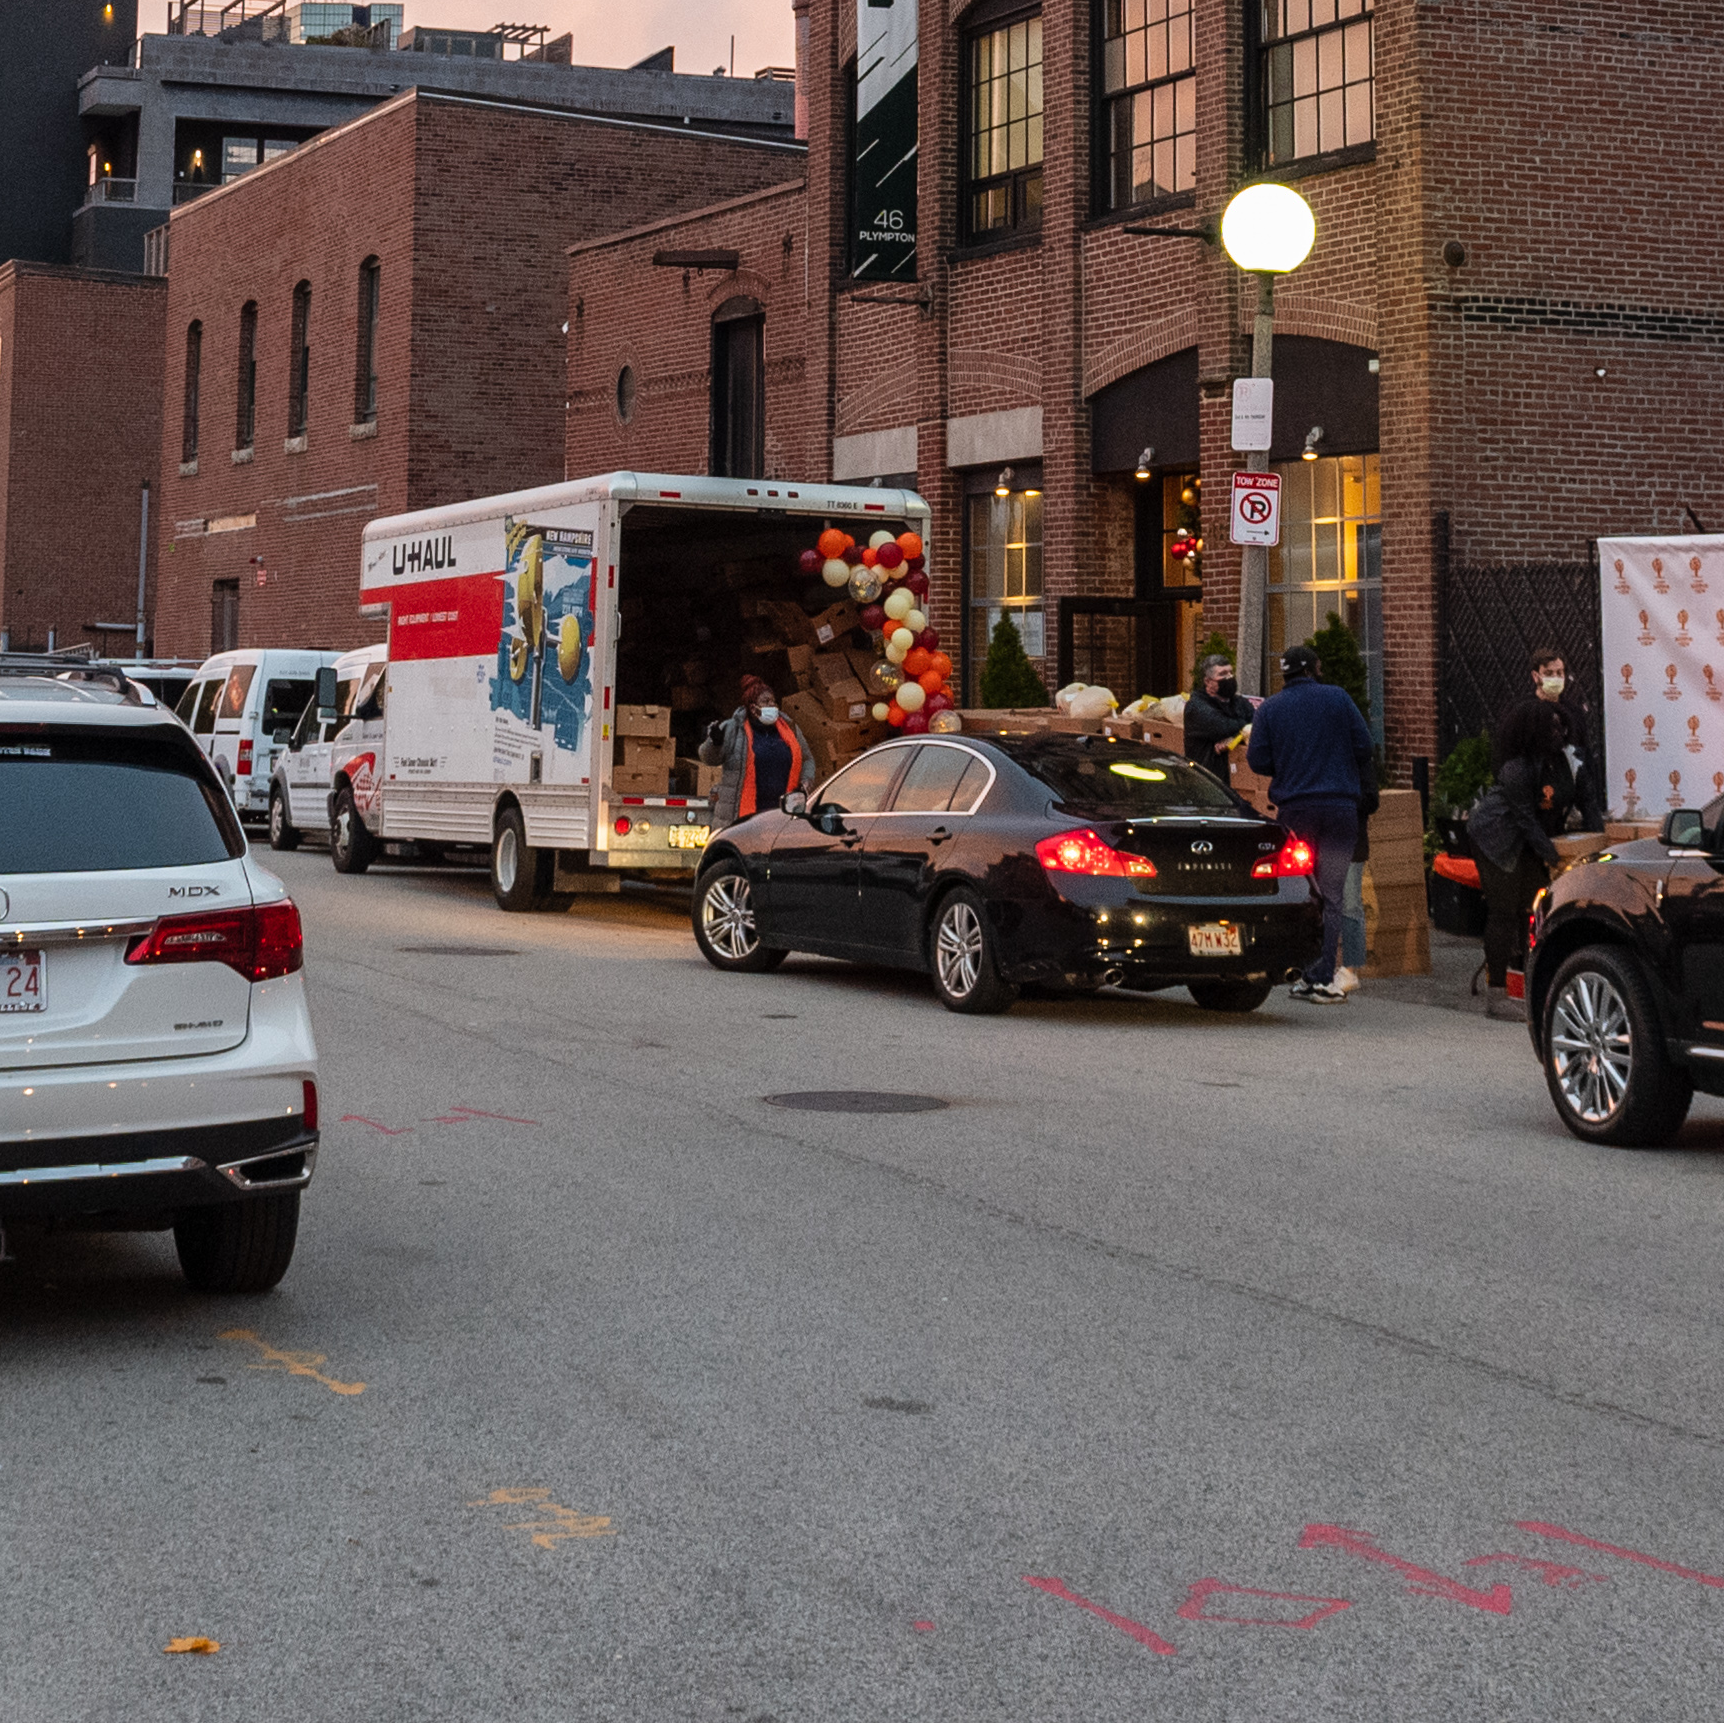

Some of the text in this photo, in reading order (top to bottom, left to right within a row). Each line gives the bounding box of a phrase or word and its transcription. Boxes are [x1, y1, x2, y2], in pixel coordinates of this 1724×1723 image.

[874, 209, 904, 230] 46
[859, 231, 915, 243] PLYMPTON
[1236, 476, 1279, 488] TOW ZONE
[546, 530, 592, 545] NEW HAMPSHIRE
[168, 885, 220, 898] MDX
[7, 966, 40, 998] 24
